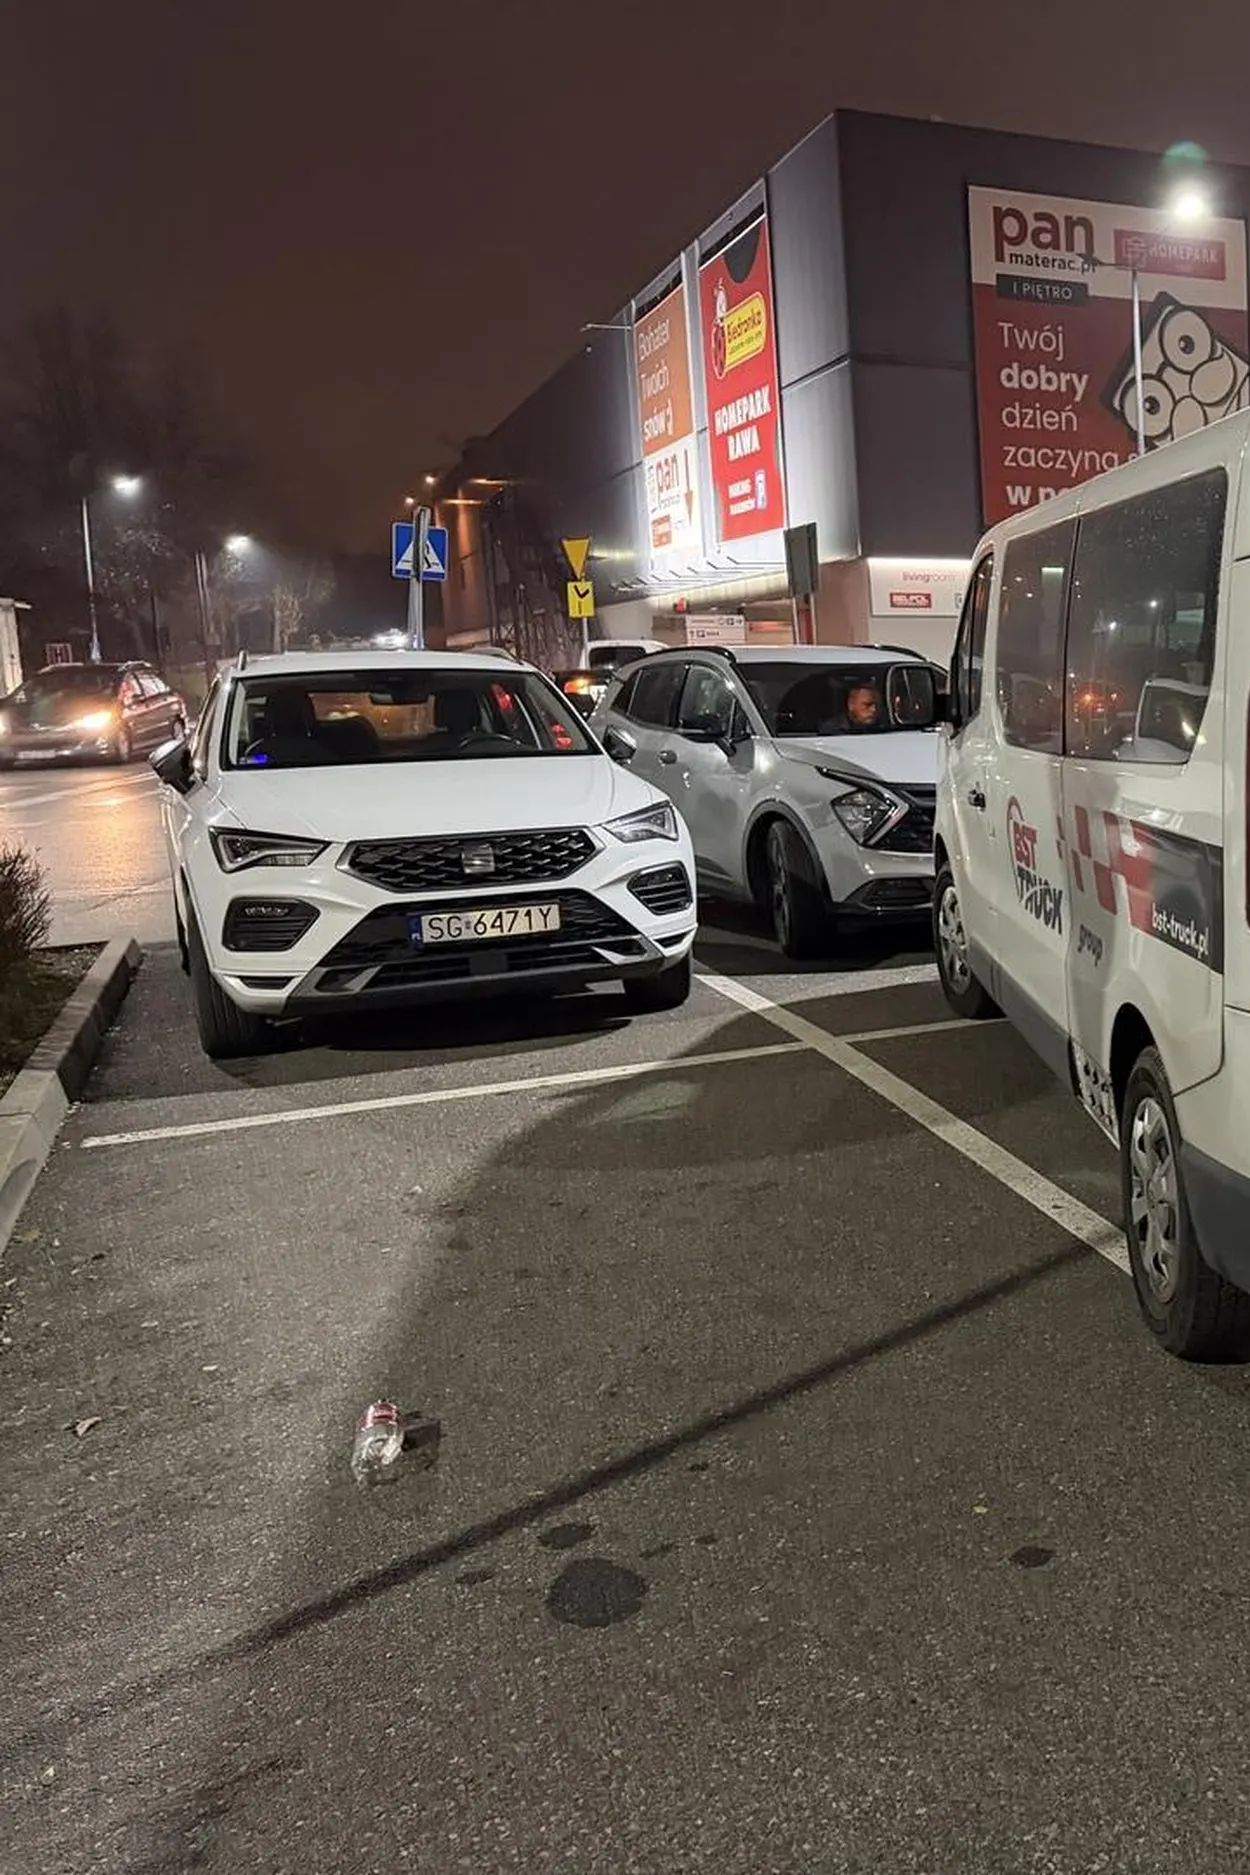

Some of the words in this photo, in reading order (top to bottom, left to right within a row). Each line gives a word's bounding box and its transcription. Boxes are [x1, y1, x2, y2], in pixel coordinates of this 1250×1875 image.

[993, 206, 1094, 263] pan
[1023, 282, 1072, 300] PIĘTRO
[998, 322, 1064, 361] Twój
[1000, 362, 1088, 402] dobry
[715, 385, 771, 436] HOMEPARK
[1001, 402, 1077, 432] dzień
[1002, 445, 1118, 477] zaczyna
[1017, 865, 1063, 935] TRUCK
[427, 914, 463, 940] SG
[473, 907, 551, 936] 6471Y
[1152, 902, 1209, 960] bst-truck.pl
